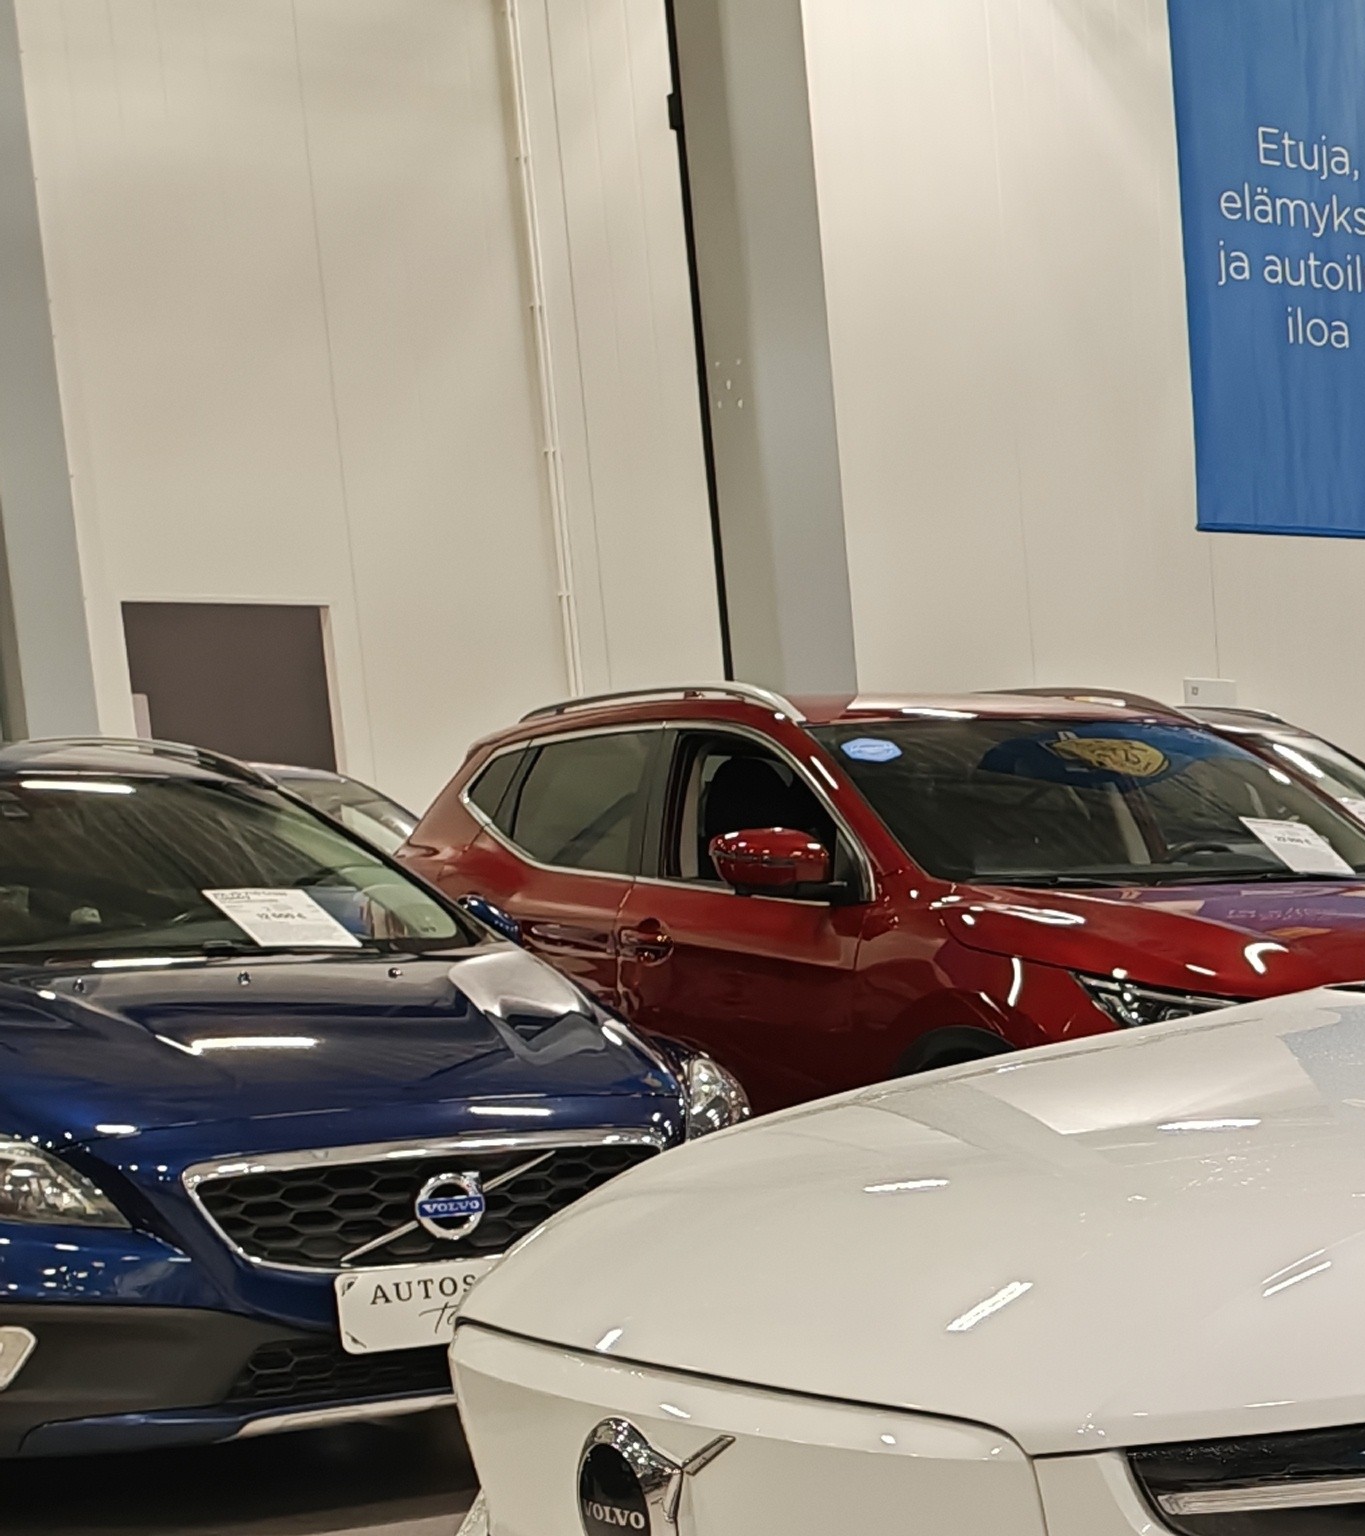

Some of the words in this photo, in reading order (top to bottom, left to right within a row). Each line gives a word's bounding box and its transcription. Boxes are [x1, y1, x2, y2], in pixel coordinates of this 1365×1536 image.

[1257, 125, 1360, 183] Etuja,
[1217, 242, 1251, 286] ja
[1286, 307, 1350, 349] iloa
[421, 1199, 481, 1214] VOLVO
[582, 1499, 646, 1531] VOLVO
